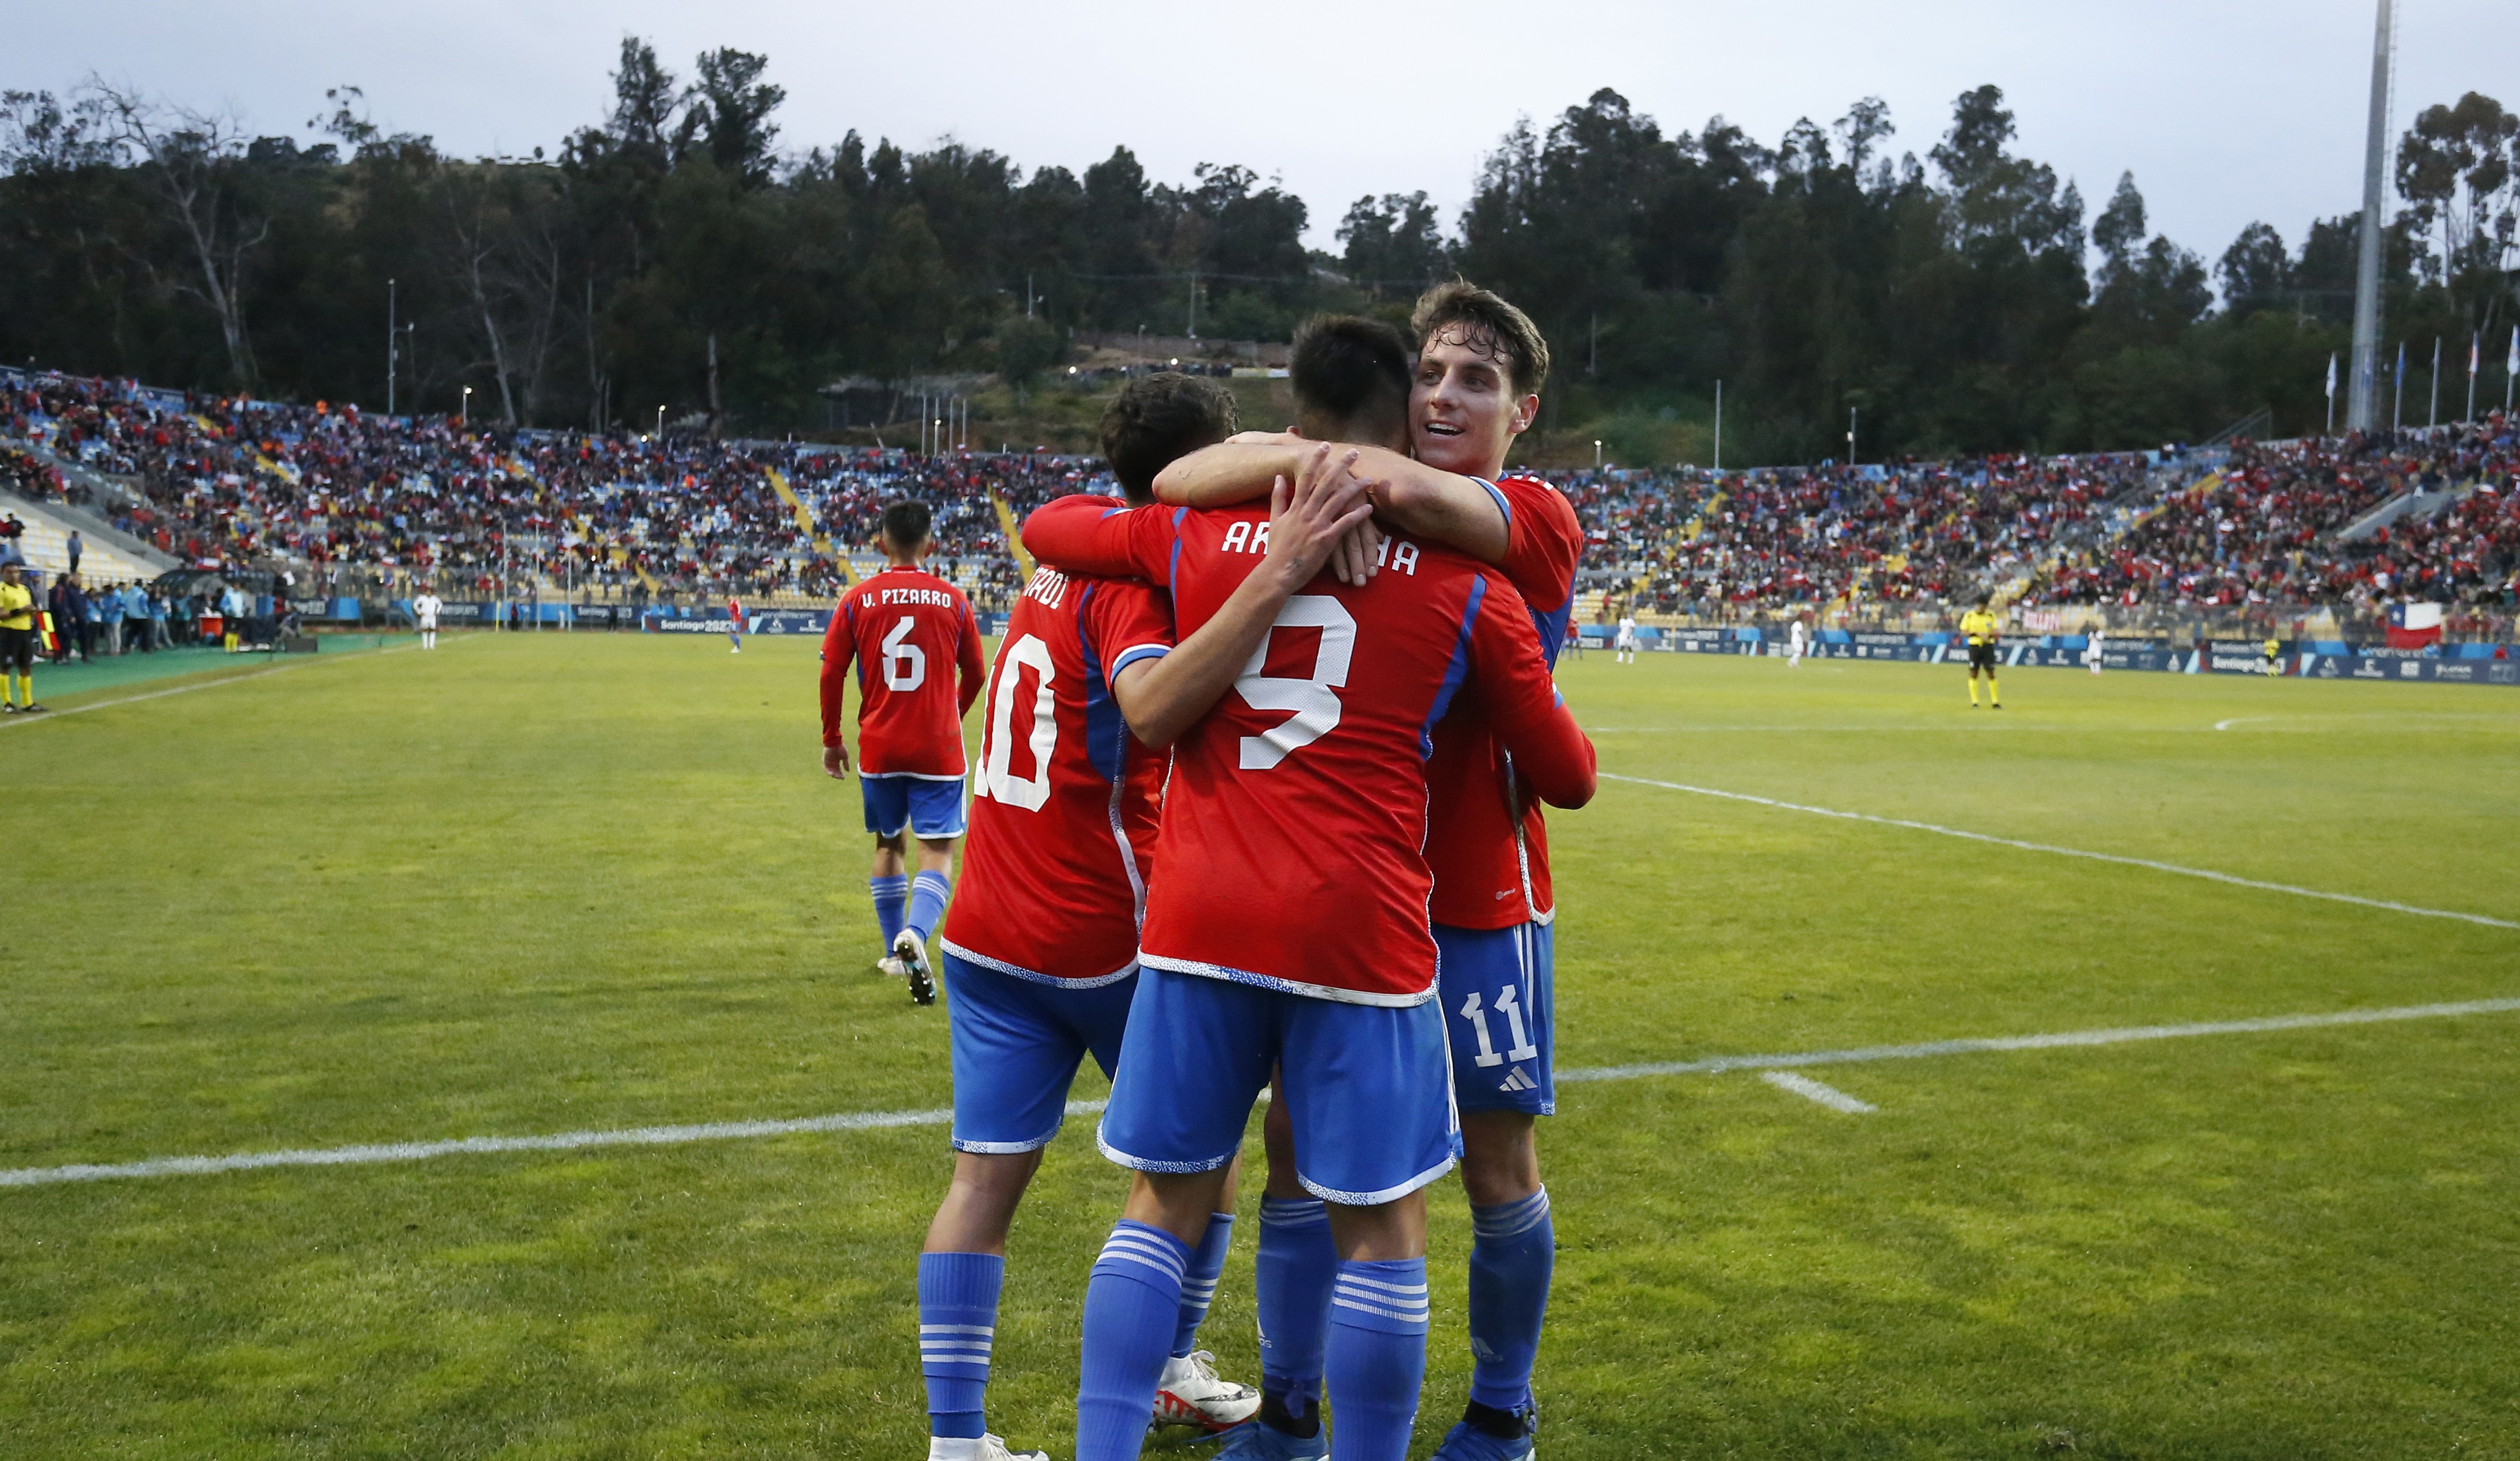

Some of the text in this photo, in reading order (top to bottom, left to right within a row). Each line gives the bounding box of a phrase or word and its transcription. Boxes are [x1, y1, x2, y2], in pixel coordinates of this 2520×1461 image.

[661, 619, 704, 632] Santiago
[881, 588, 951, 608] PIZARRO
[881, 615, 925, 691] 6
[1233, 595, 1358, 770] 9
[1460, 984, 1538, 1068] 11
